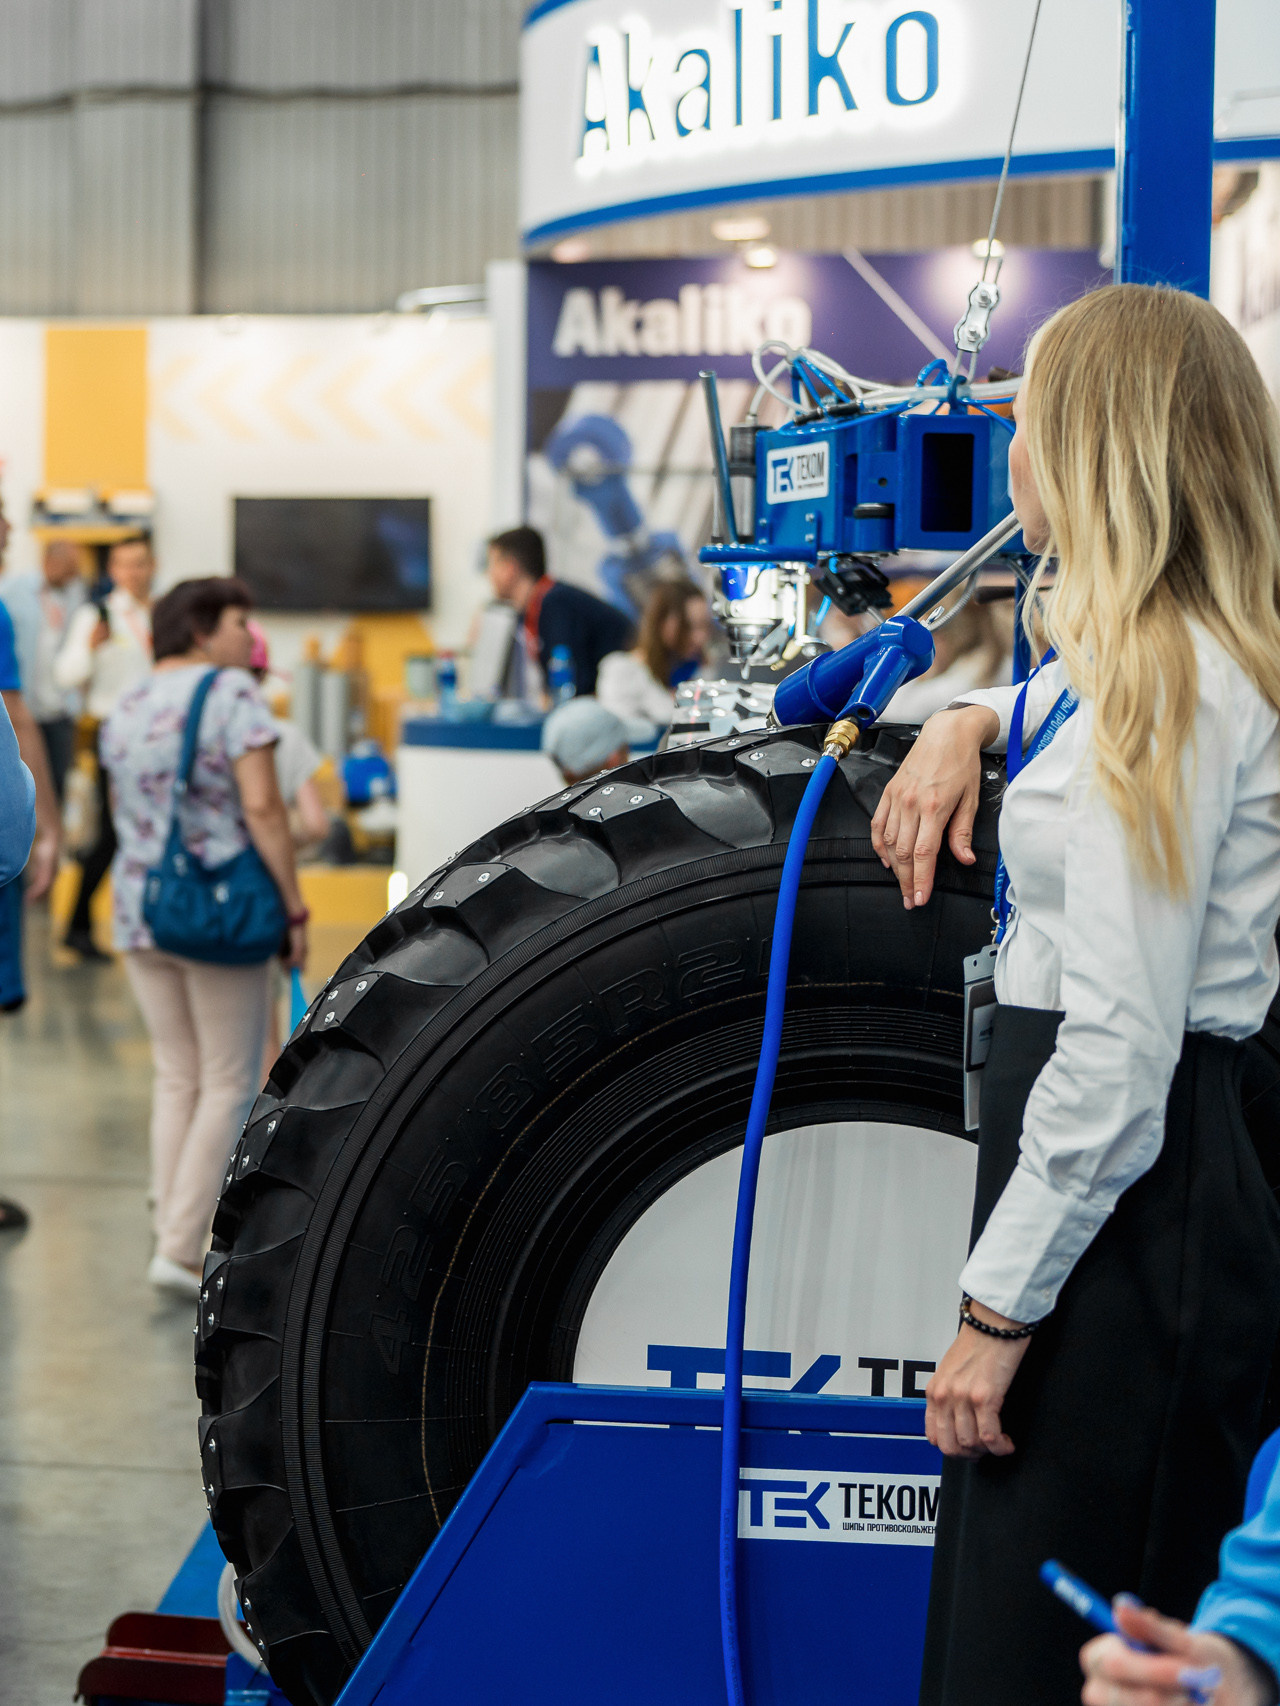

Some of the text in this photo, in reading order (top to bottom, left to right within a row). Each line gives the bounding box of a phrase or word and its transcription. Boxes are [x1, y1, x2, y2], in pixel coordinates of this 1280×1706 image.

[581, 0, 939, 157] Akaliko
[552, 283, 812, 357] Akaliko
[842, 1522, 865, 1532] ШИПЫ
